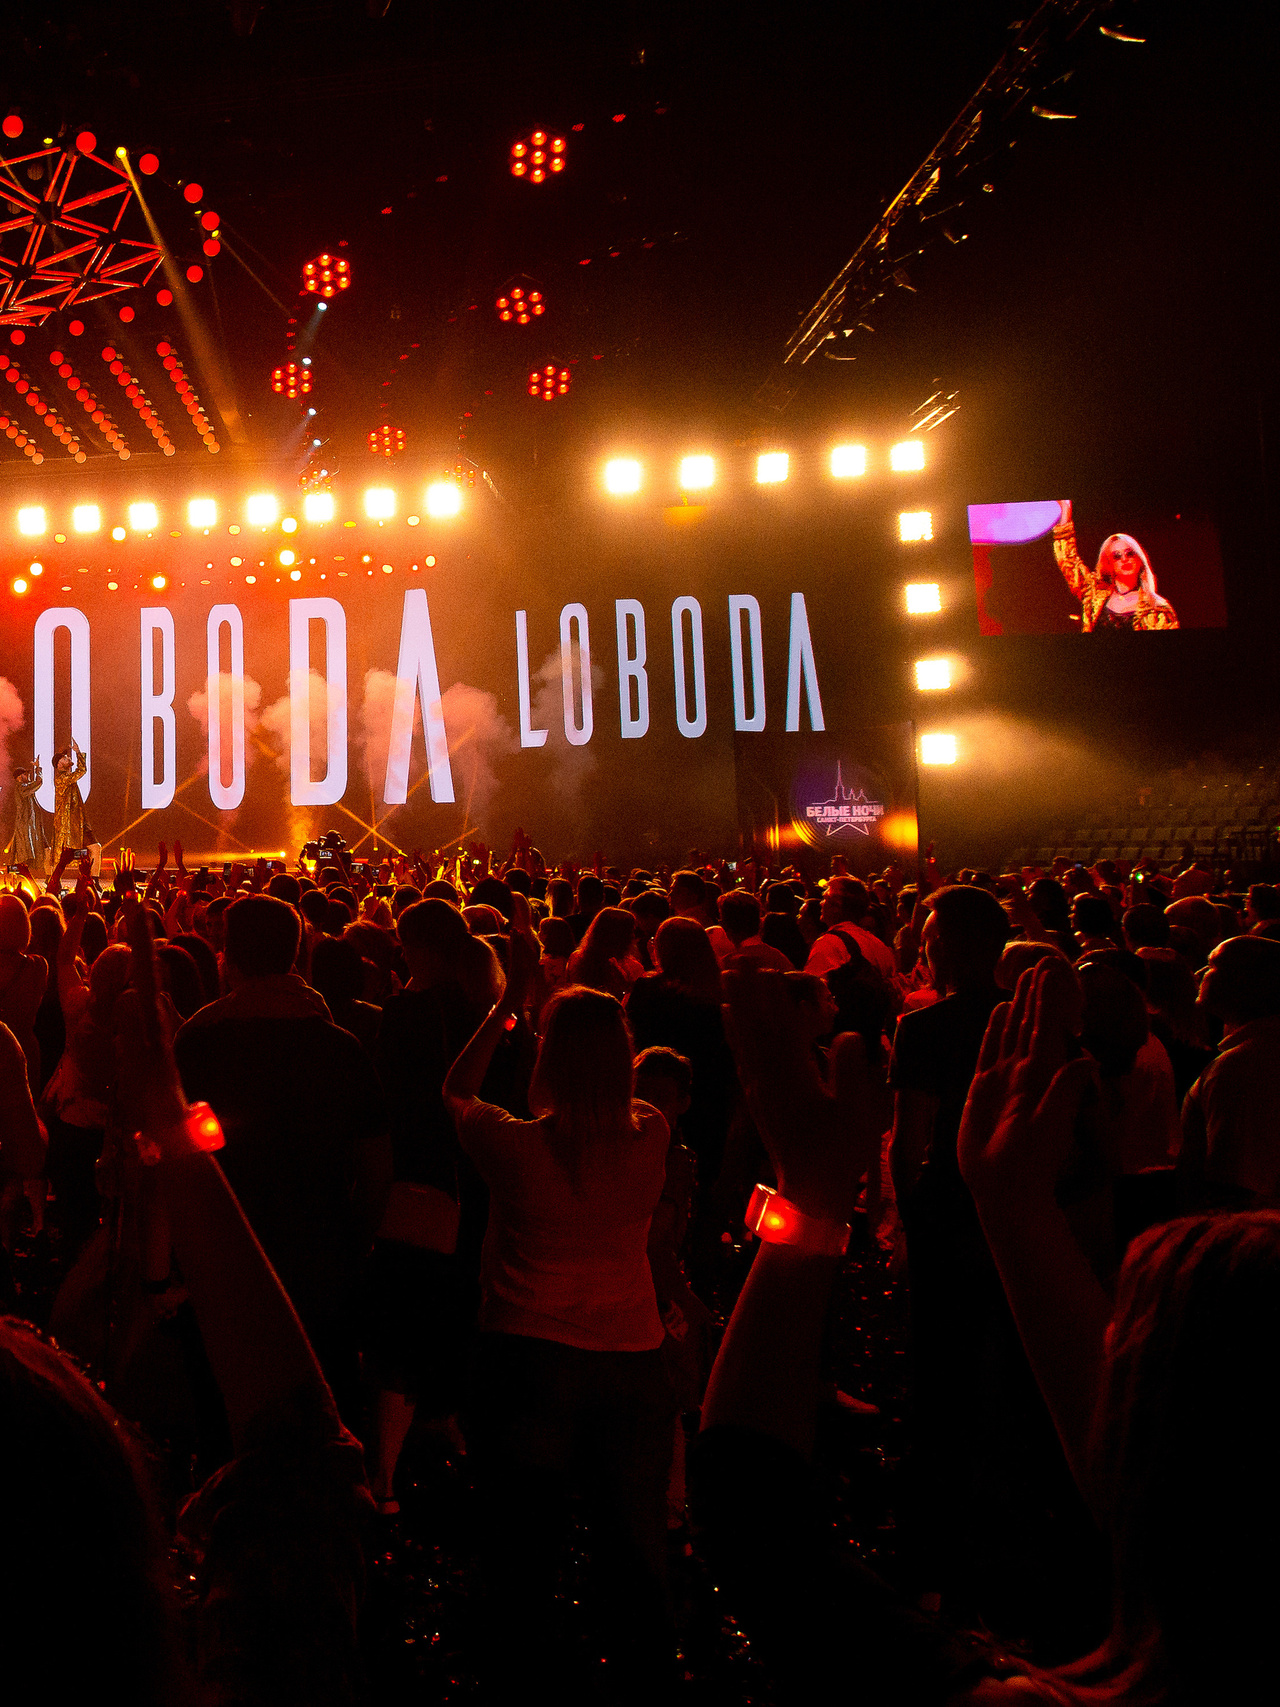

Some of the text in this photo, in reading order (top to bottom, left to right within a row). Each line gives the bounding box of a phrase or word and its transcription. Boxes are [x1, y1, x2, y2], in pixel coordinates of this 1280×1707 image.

[515, 592, 825, 748] LOBODA
[806, 805, 884, 817] БЕЛЫЕ НОЧИ
